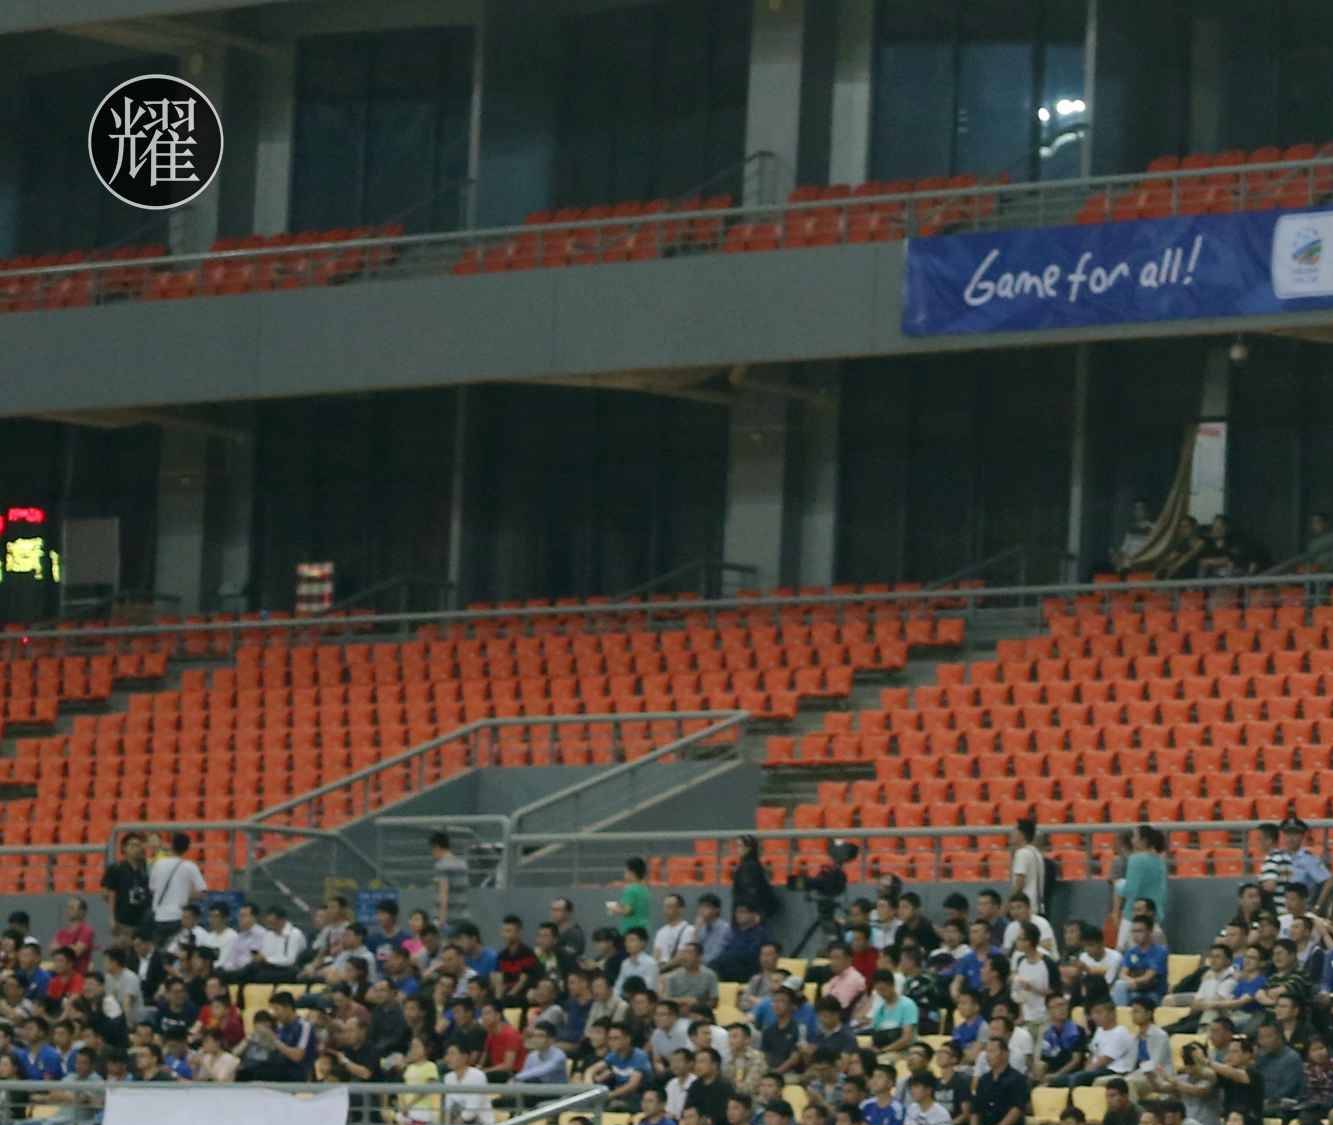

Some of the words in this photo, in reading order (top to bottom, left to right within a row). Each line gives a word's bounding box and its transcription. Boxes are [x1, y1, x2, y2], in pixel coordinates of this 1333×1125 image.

[963, 248, 1061, 306] Game
[1067, 252, 1130, 303] for
[1139, 234, 1203, 288] all!
